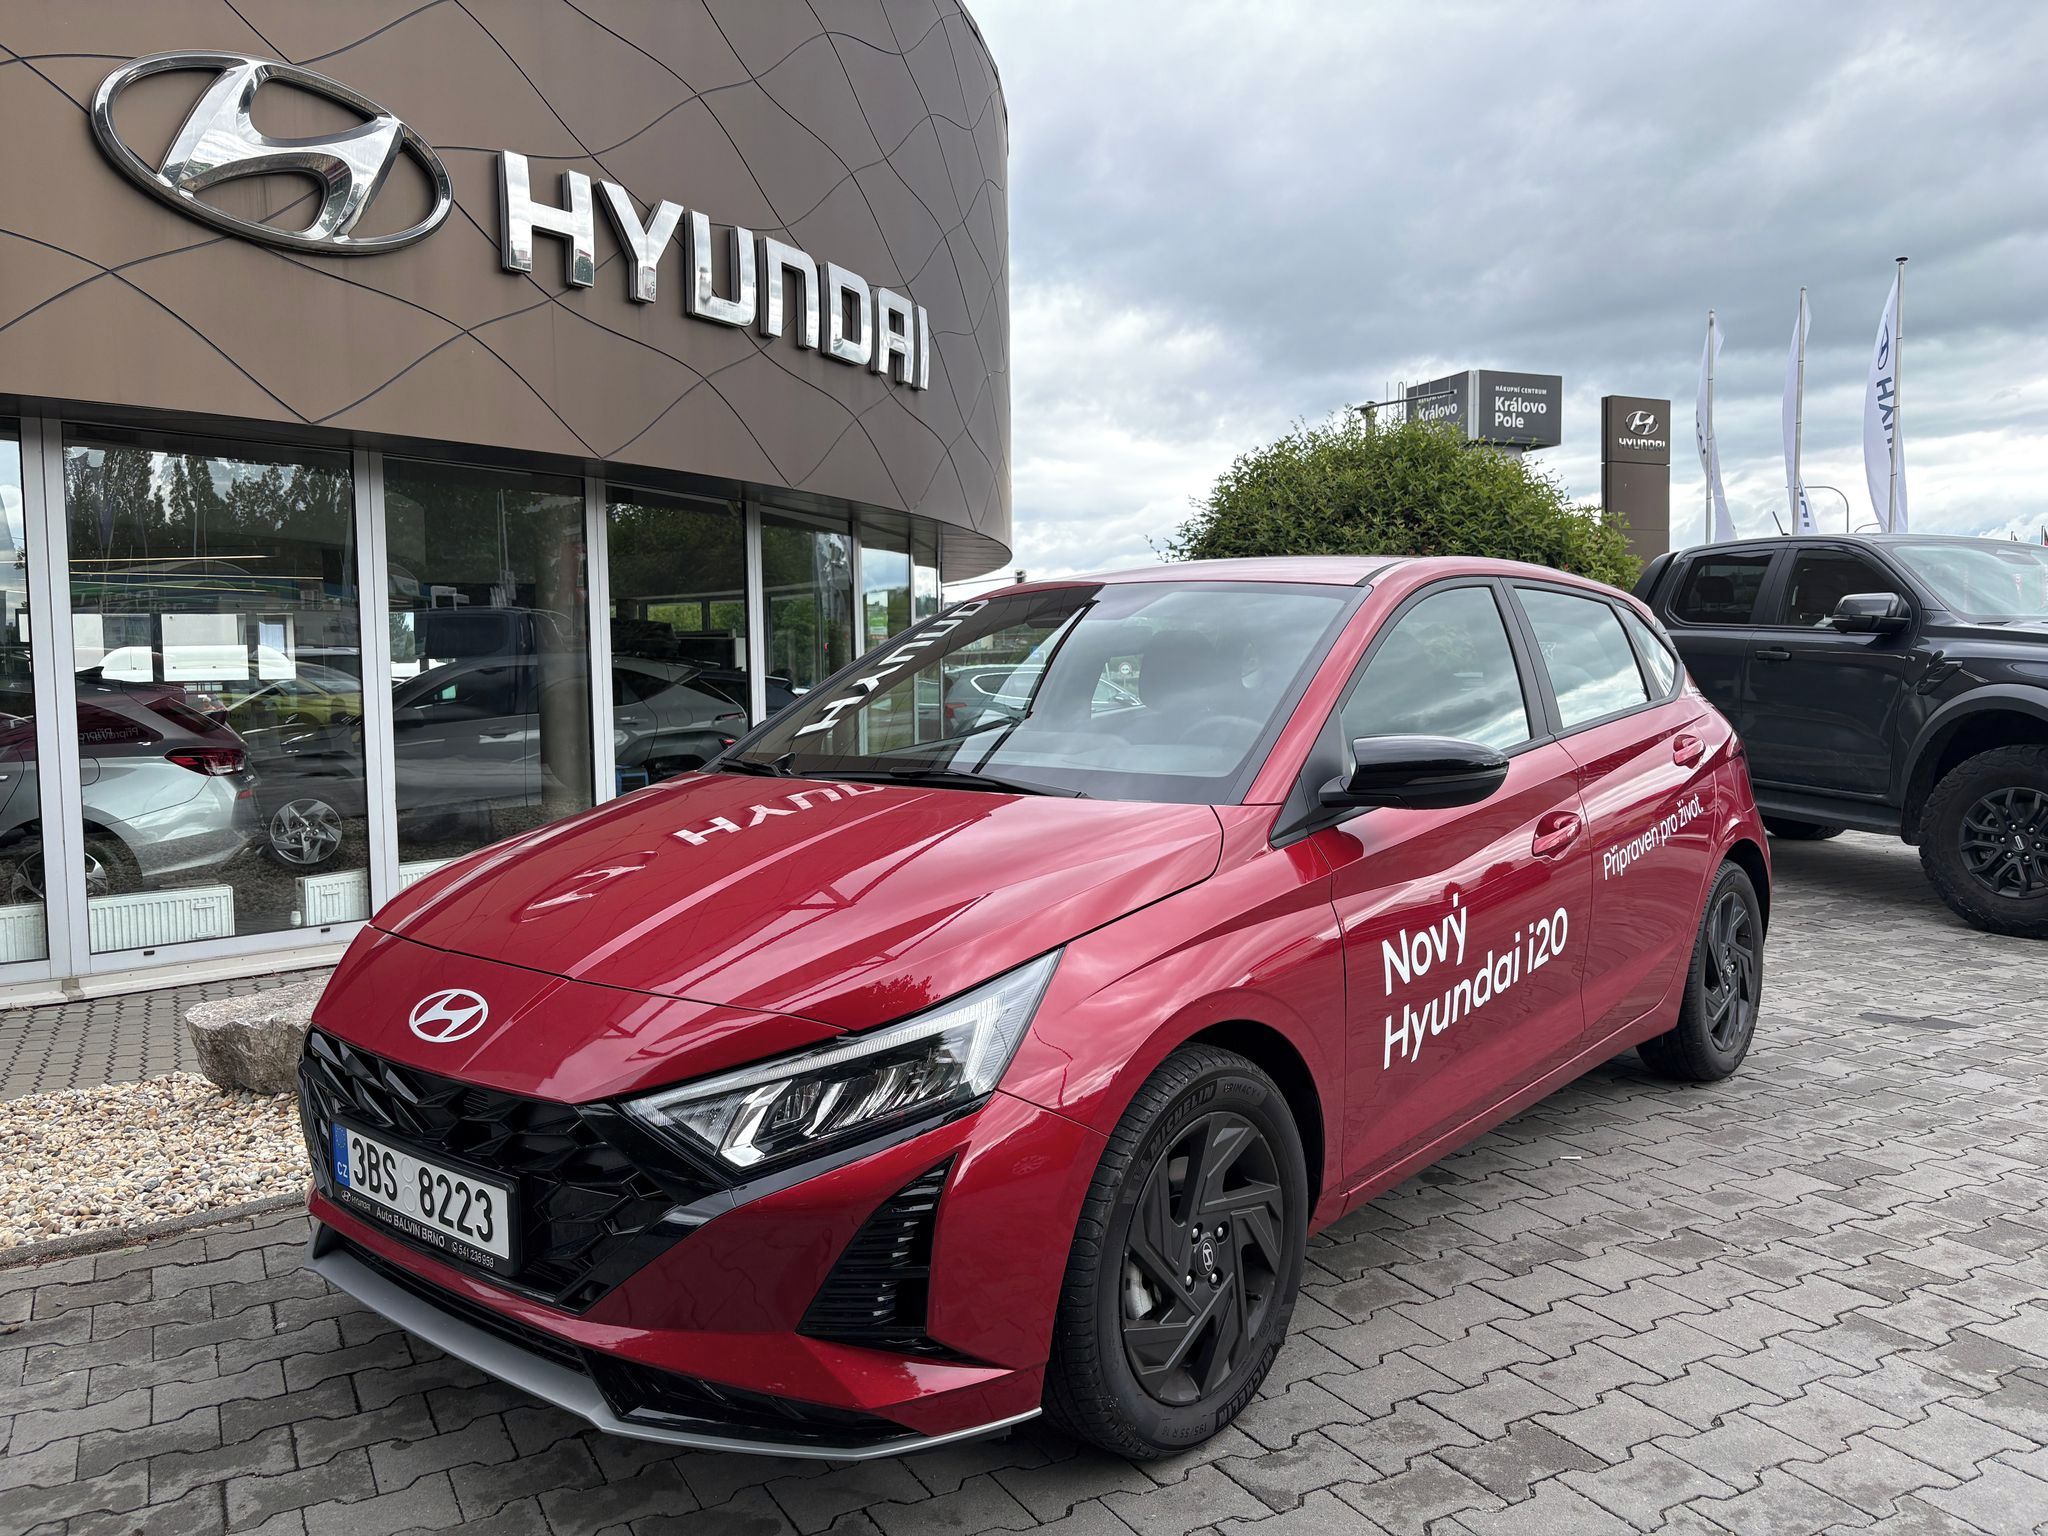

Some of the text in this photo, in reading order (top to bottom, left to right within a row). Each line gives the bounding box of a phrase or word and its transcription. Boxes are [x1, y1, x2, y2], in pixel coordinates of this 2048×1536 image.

[497, 149, 930, 391] HYUNDAI
[1495, 384, 1547, 395] NÁKUPNÍ CENTRUM
[1495, 395, 1547, 414] Královo
[1495, 412, 1524, 428] Pole
[1618, 437, 1666, 450] HYUNDAI
[1603, 793, 1704, 880] Připraven pro život.
[1382, 892, 1467, 996] Nový
[1384, 907, 1568, 1070] Hyundai i20
[1150, 1085, 1214, 1157] MICHELIN
[337, 1161, 348, 1178] CZ
[352, 1137, 493, 1242] 3BS 8223
[376, 1207, 445, 1248] Auto BALVIN BRNO
